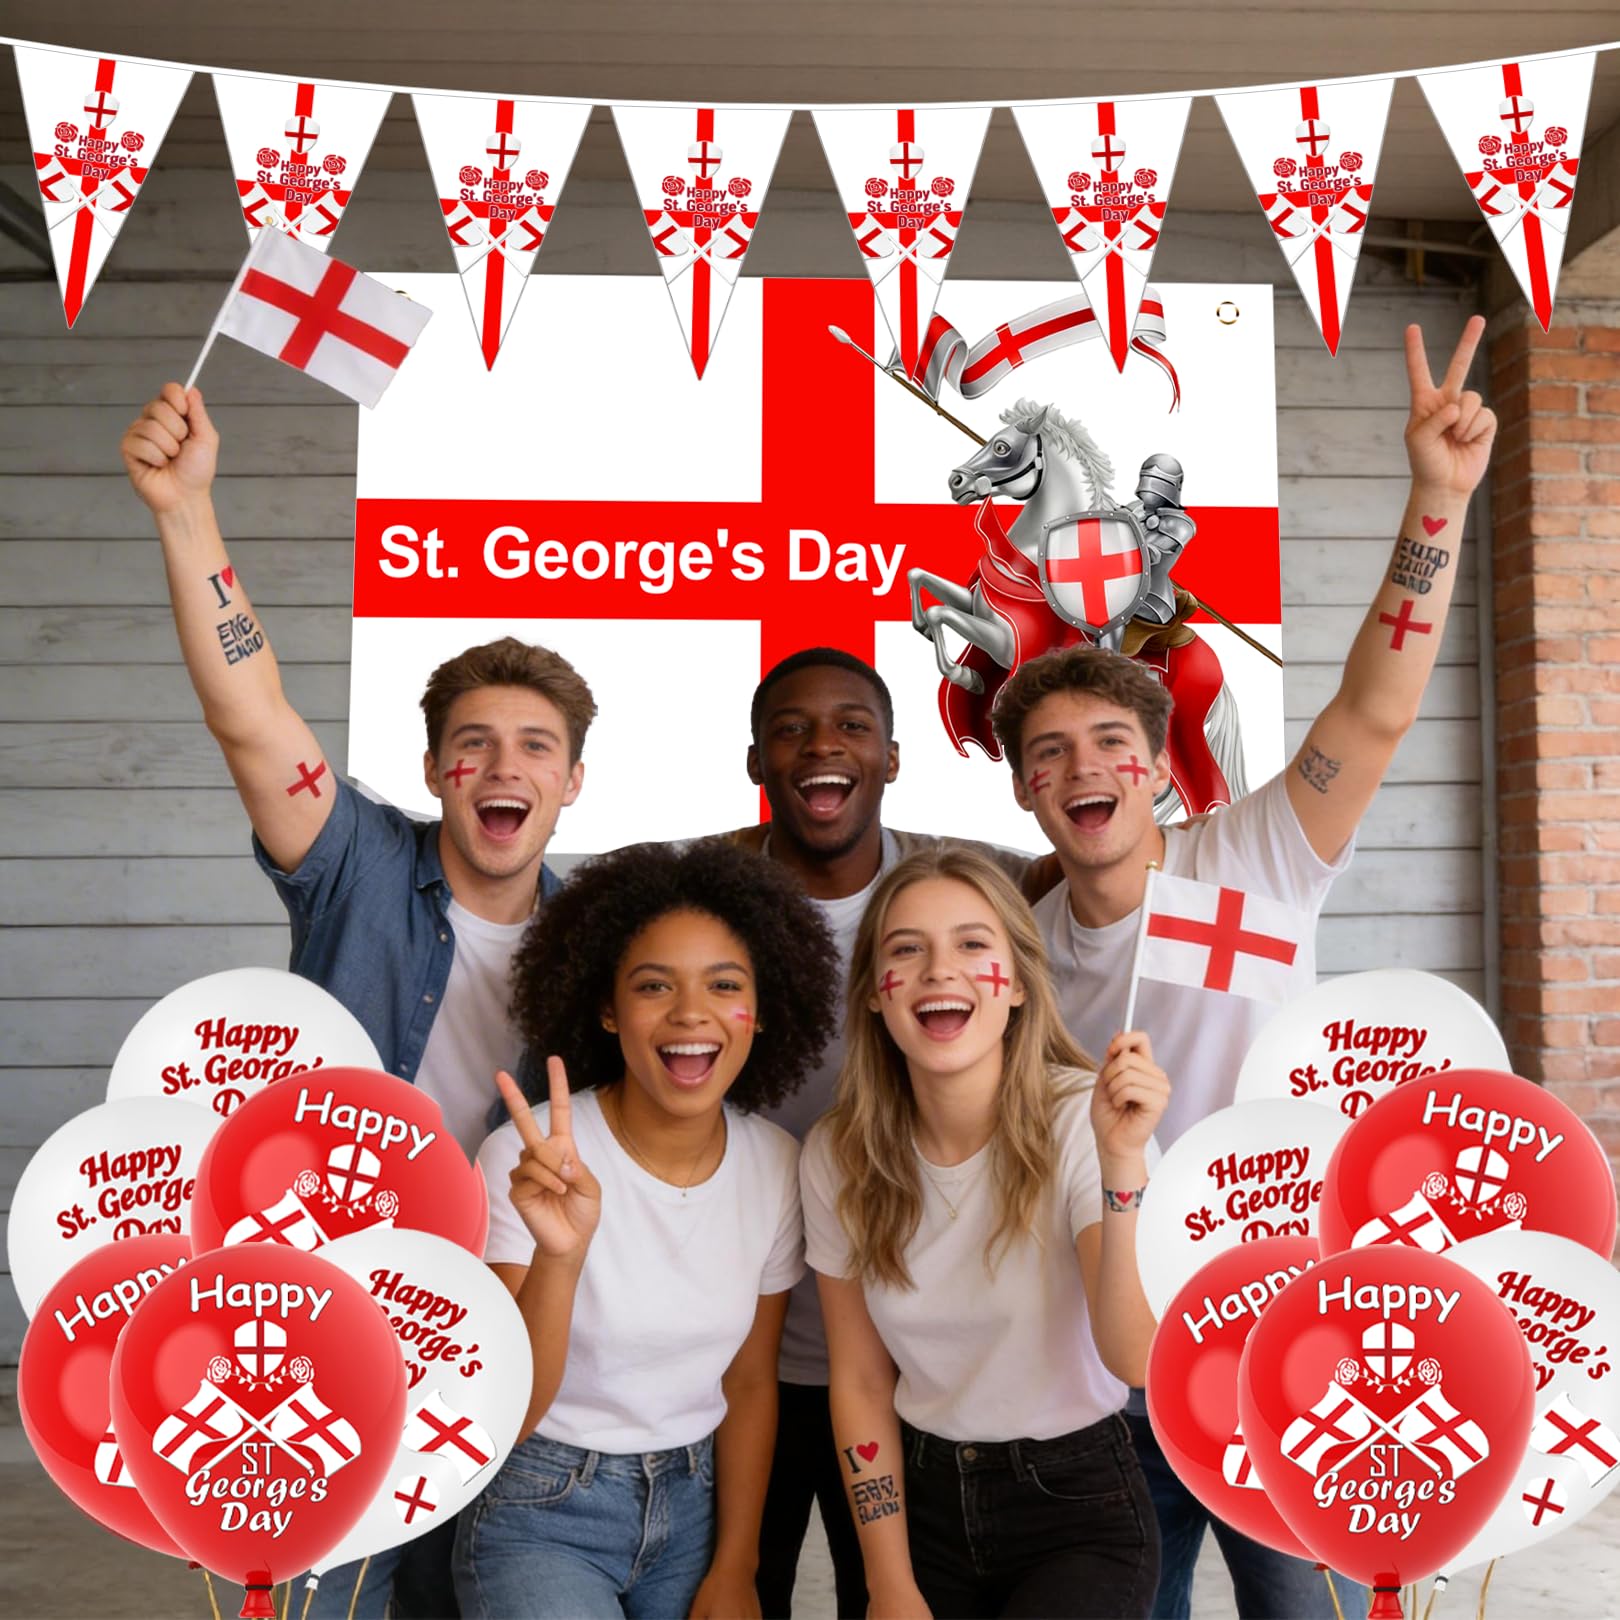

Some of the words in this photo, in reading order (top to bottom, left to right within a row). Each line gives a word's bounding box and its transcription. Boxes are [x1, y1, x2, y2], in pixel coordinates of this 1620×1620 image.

[79, 135, 119, 152] Happy
[1503, 140, 1544, 157] Happy
[54, 144, 72, 158] St.
[77, 148, 138, 167] George's
[1483, 157, 1502, 172] St.
[1505, 150, 1567, 170] George's
[82, 163, 109, 181] Day
[280, 160, 321, 177] Happy
[1299, 164, 1340, 181] Happy
[1515, 168, 1542, 184] Day
[256, 170, 275, 184] St.
[279, 173, 341, 191] George's
[483, 177, 523, 194] Happy
[1093, 180, 1134, 196] Happy
[1277, 179, 1296, 194] St.
[1300, 174, 1362, 193] George's
[285, 188, 312, 205] Day
[459, 188, 478, 202] St.
[482, 190, 544, 207] George's
[686, 187, 727, 203] Happy
[889, 187, 930, 203] Happy
[1070, 194, 1090, 208] St.
[1094, 191, 1156, 208] George's
[1309, 192, 1337, 208] Day
[489, 205, 516, 221] Day
[663, 198, 683, 213] St.
[686, 199, 748, 216] George's
[867, 200, 886, 214] St.
[889, 200, 952, 216] George's
[1102, 207, 1129, 224] Day
[694, 215, 721, 231] Day
[897, 215, 924, 231] Day
[378, 524, 459, 579] St.
[482, 525, 765, 595] George's
[788, 529, 906, 596] Day
[195, 1018, 298, 1053] Happy
[1323, 1020, 1426, 1057] Happy
[161, 1062, 201, 1095] St.
[1289, 1064, 1329, 1097] St.
[295, 1088, 436, 1160] Happy
[1422, 1090, 1565, 1163] Happy
[80, 1145, 181, 1187] Happy
[1207, 1147, 1309, 1189] Happy
[57, 1204, 97, 1239] St.
[98, 1178, 196, 1218] George
[1185, 1206, 1225, 1241] St.
[1226, 1180, 1323, 1220] George
[190, 1273, 333, 1322] Happy
[369, 1269, 467, 1330] Happy
[1317, 1276, 1461, 1324] Happy
[1497, 1271, 1596, 1332] Happy
[381, 1305, 483, 1377] eorge's
[1509, 1307, 1611, 1379] eorge's
[242, 1442, 276, 1475] ST
[1369, 1444, 1403, 1477] ST
[185, 1469, 328, 1506] George's
[1313, 1471, 1456, 1508] George's
[220, 1502, 293, 1538] Day
[1348, 1504, 1421, 1540] Day
